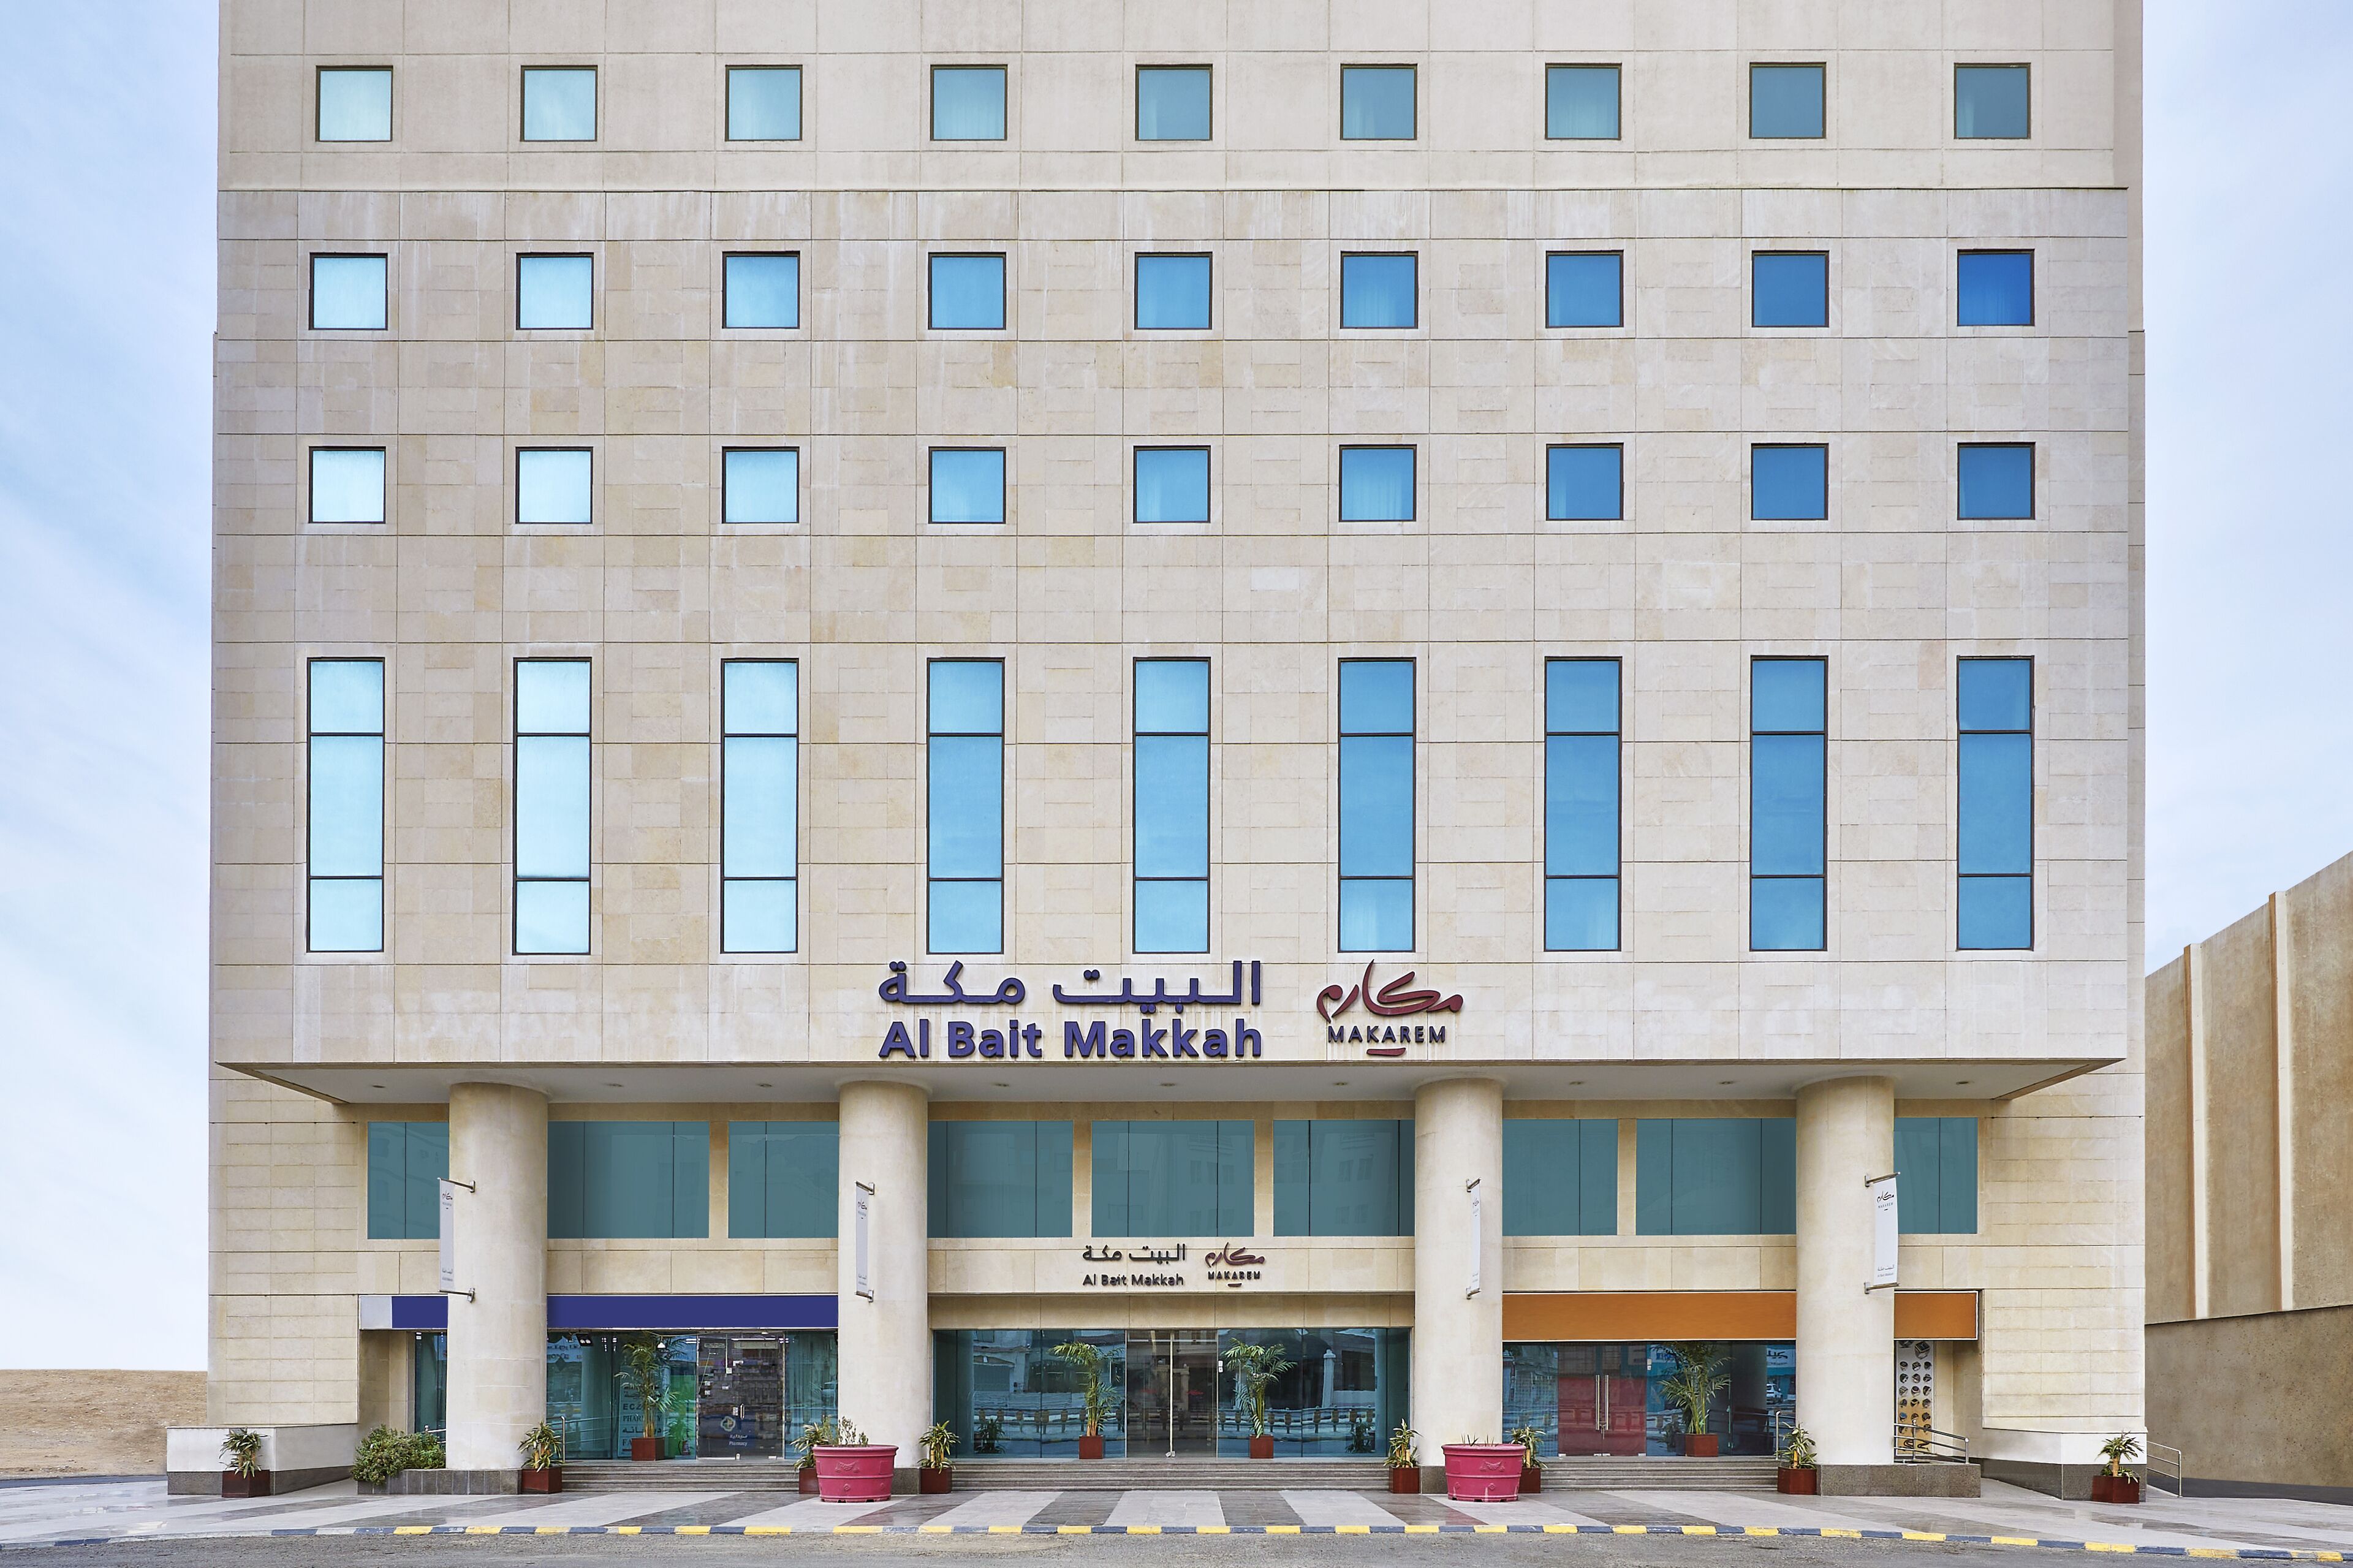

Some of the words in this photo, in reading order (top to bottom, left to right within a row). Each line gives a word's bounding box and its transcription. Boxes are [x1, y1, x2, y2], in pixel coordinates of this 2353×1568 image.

[878, 961, 1026, 1004] مكة
[1052, 960, 1261, 1014] البيت
[1316, 958, 1463, 1022] مكارم
[879, 1019, 930, 1058] Al
[948, 1019, 1042, 1059] Bait
[1064, 1019, 1262, 1058] Makkah
[1328, 1025, 1446, 1044] MAKAREM
[1082, 1244, 1122, 1262] مكة
[1129, 1243, 1186, 1265] البيت
[1205, 1242, 1265, 1268] مكارم
[1082, 1274, 1096, 1286] Al
[1101, 1274, 1126, 1286] Bait
[1132, 1273, 1184, 1286] Makkah
[1208, 1271, 1260, 1280] MAKAREM
